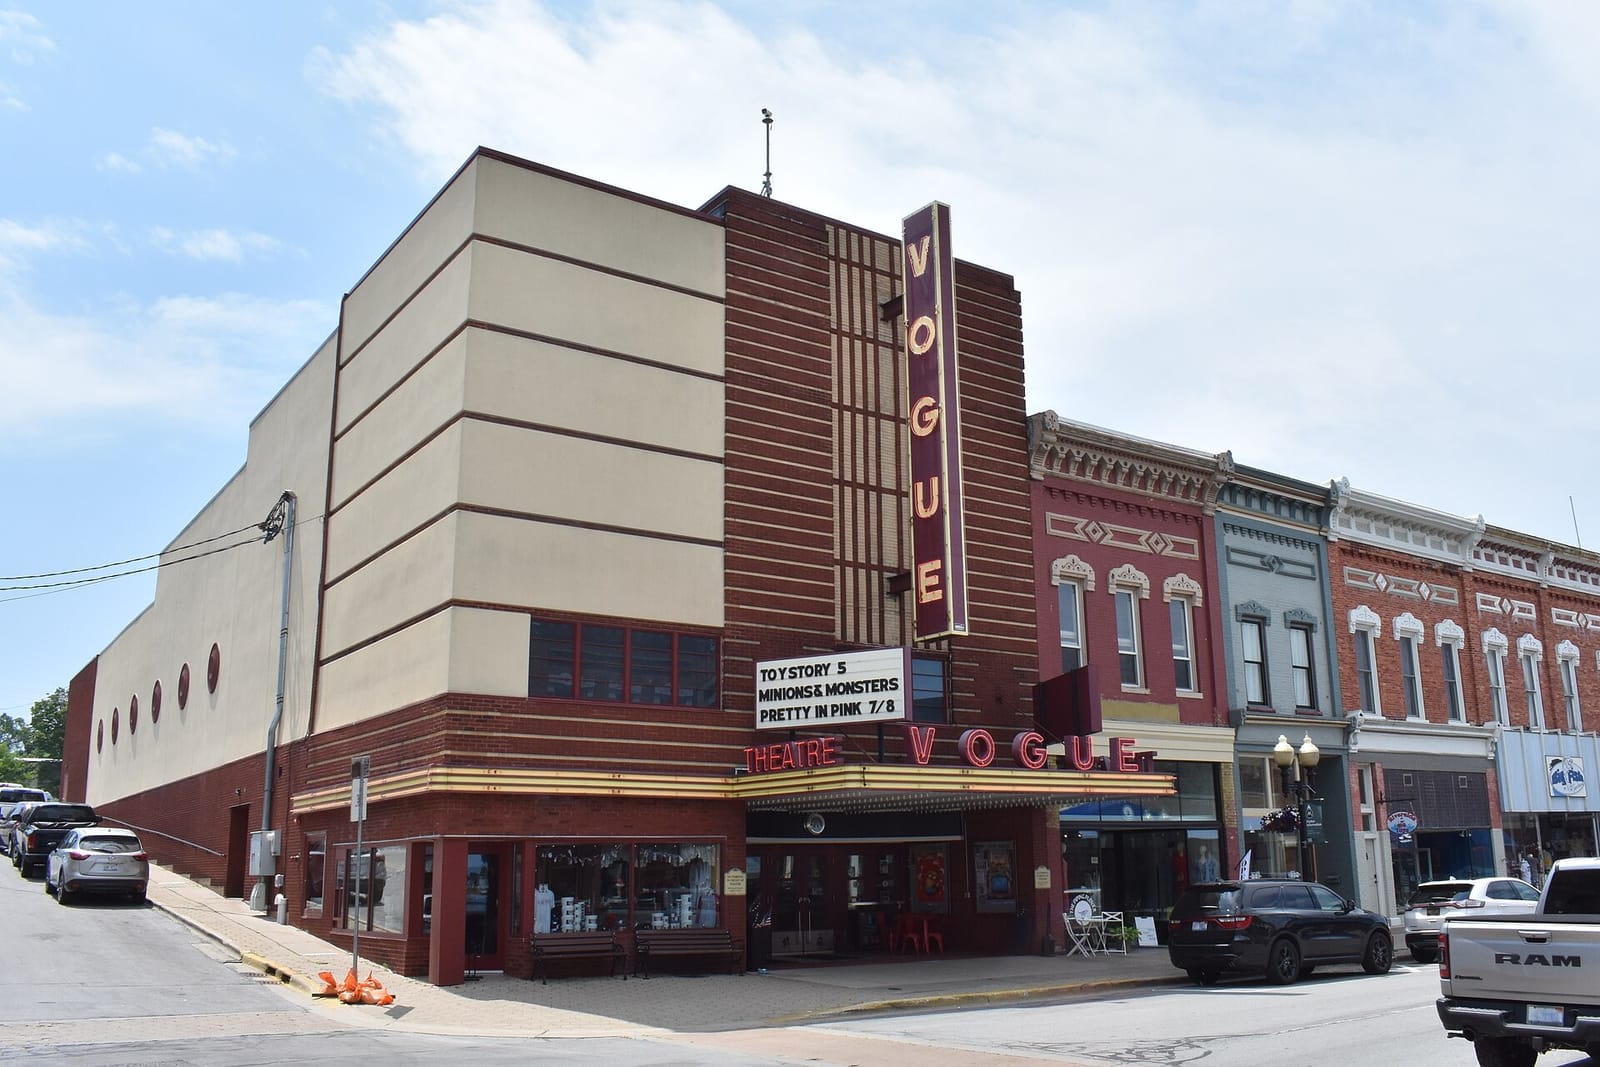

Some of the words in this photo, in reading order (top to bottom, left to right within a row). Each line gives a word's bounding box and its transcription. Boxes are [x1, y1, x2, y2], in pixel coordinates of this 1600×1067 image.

[906, 235, 943, 603] VOGUE
[837, 662, 847, 675] 5
[825, 677, 899, 697] MONSTERS
[760, 706, 811, 723] PRETTY
[815, 704, 828, 719] IN
[831, 702, 862, 718] PINK
[869, 699, 895, 714] 7/8
[743, 736, 837, 773] THEATRE
[910, 726, 1140, 772] VOGUE
[1495, 953, 1582, 968] RAM
